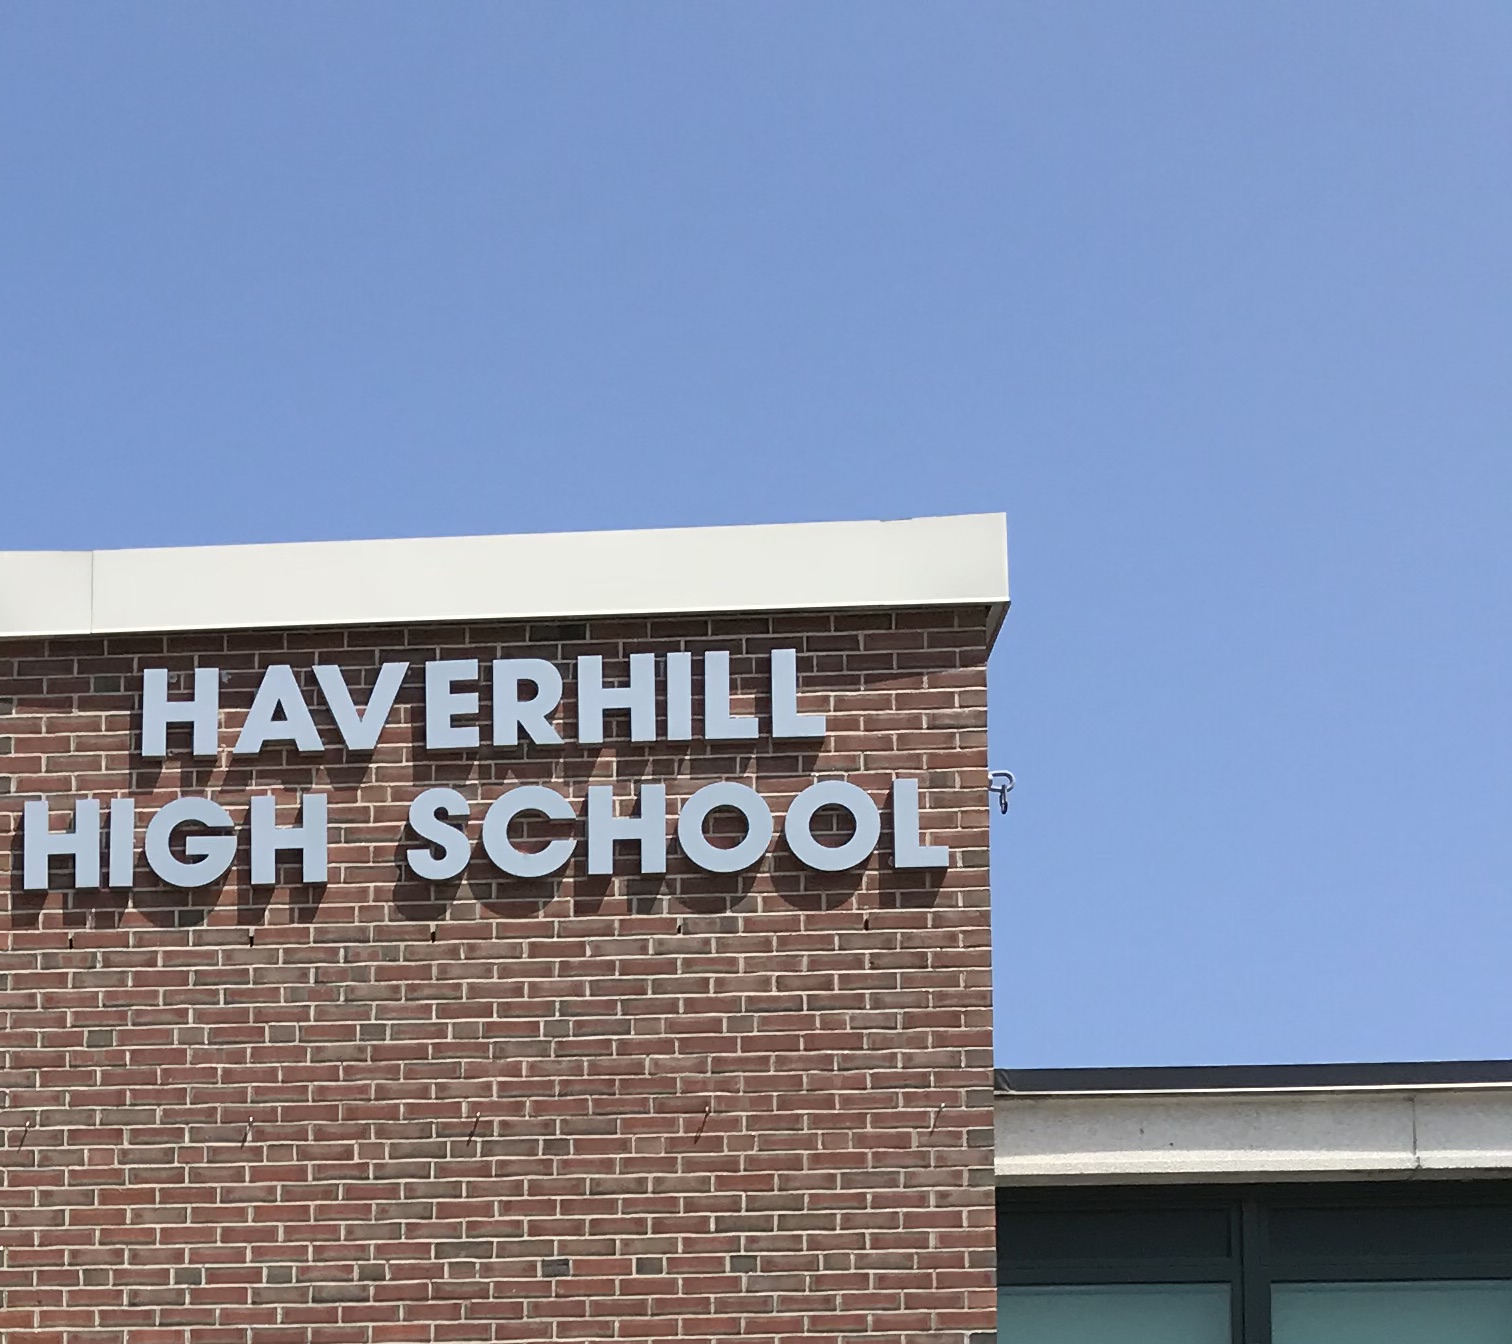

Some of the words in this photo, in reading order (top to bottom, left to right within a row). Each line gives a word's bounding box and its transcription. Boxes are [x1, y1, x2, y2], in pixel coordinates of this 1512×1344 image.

[142, 648, 826, 757] HAVERHILL
[23, 793, 329, 890] HIGH
[406, 778, 950, 880] SCHOOL
